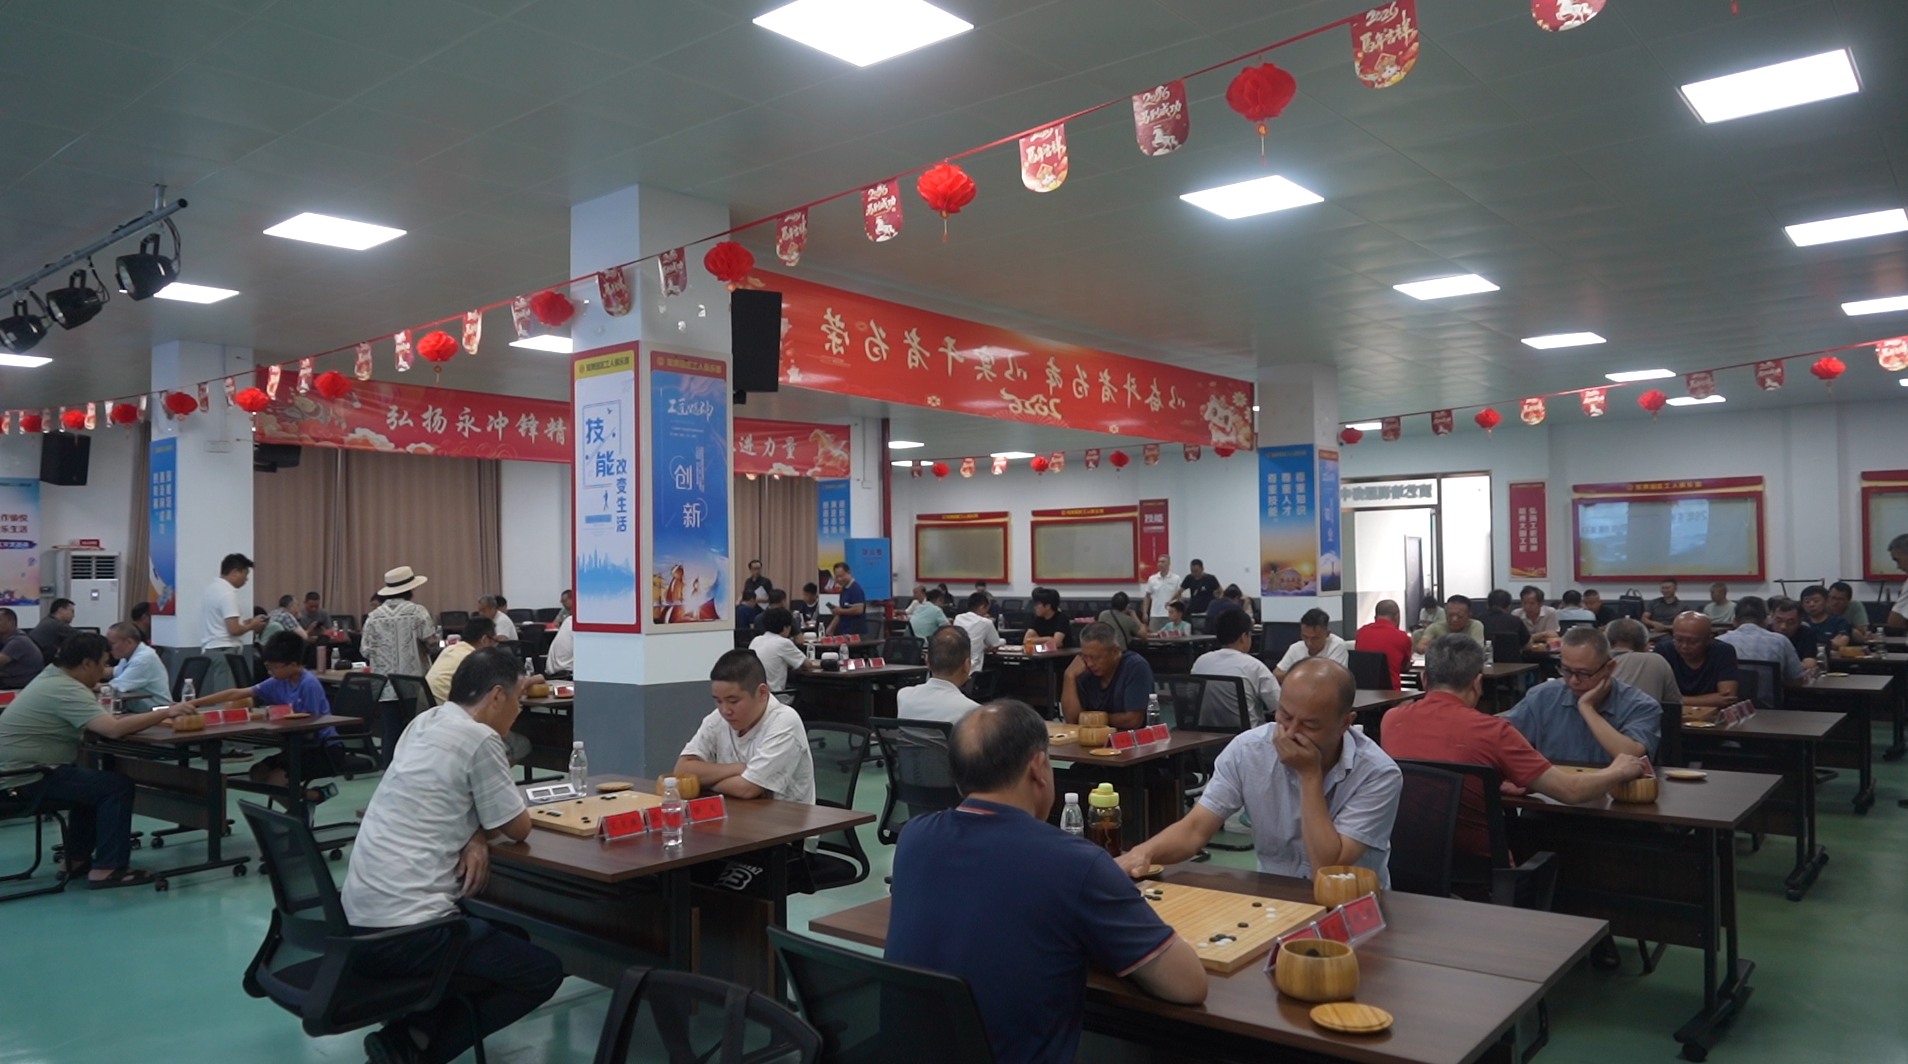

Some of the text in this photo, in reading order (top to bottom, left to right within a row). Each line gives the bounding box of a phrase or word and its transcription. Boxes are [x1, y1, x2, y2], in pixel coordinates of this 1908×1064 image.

[1365, 1, 1399, 27] 2026
[386, 404, 797, 460] 弘扬永冲锋精 进力量
[585, 418, 615, 478] 技能
[616, 458, 628, 533] 改变生活
[673, 464, 701, 529] 创新
